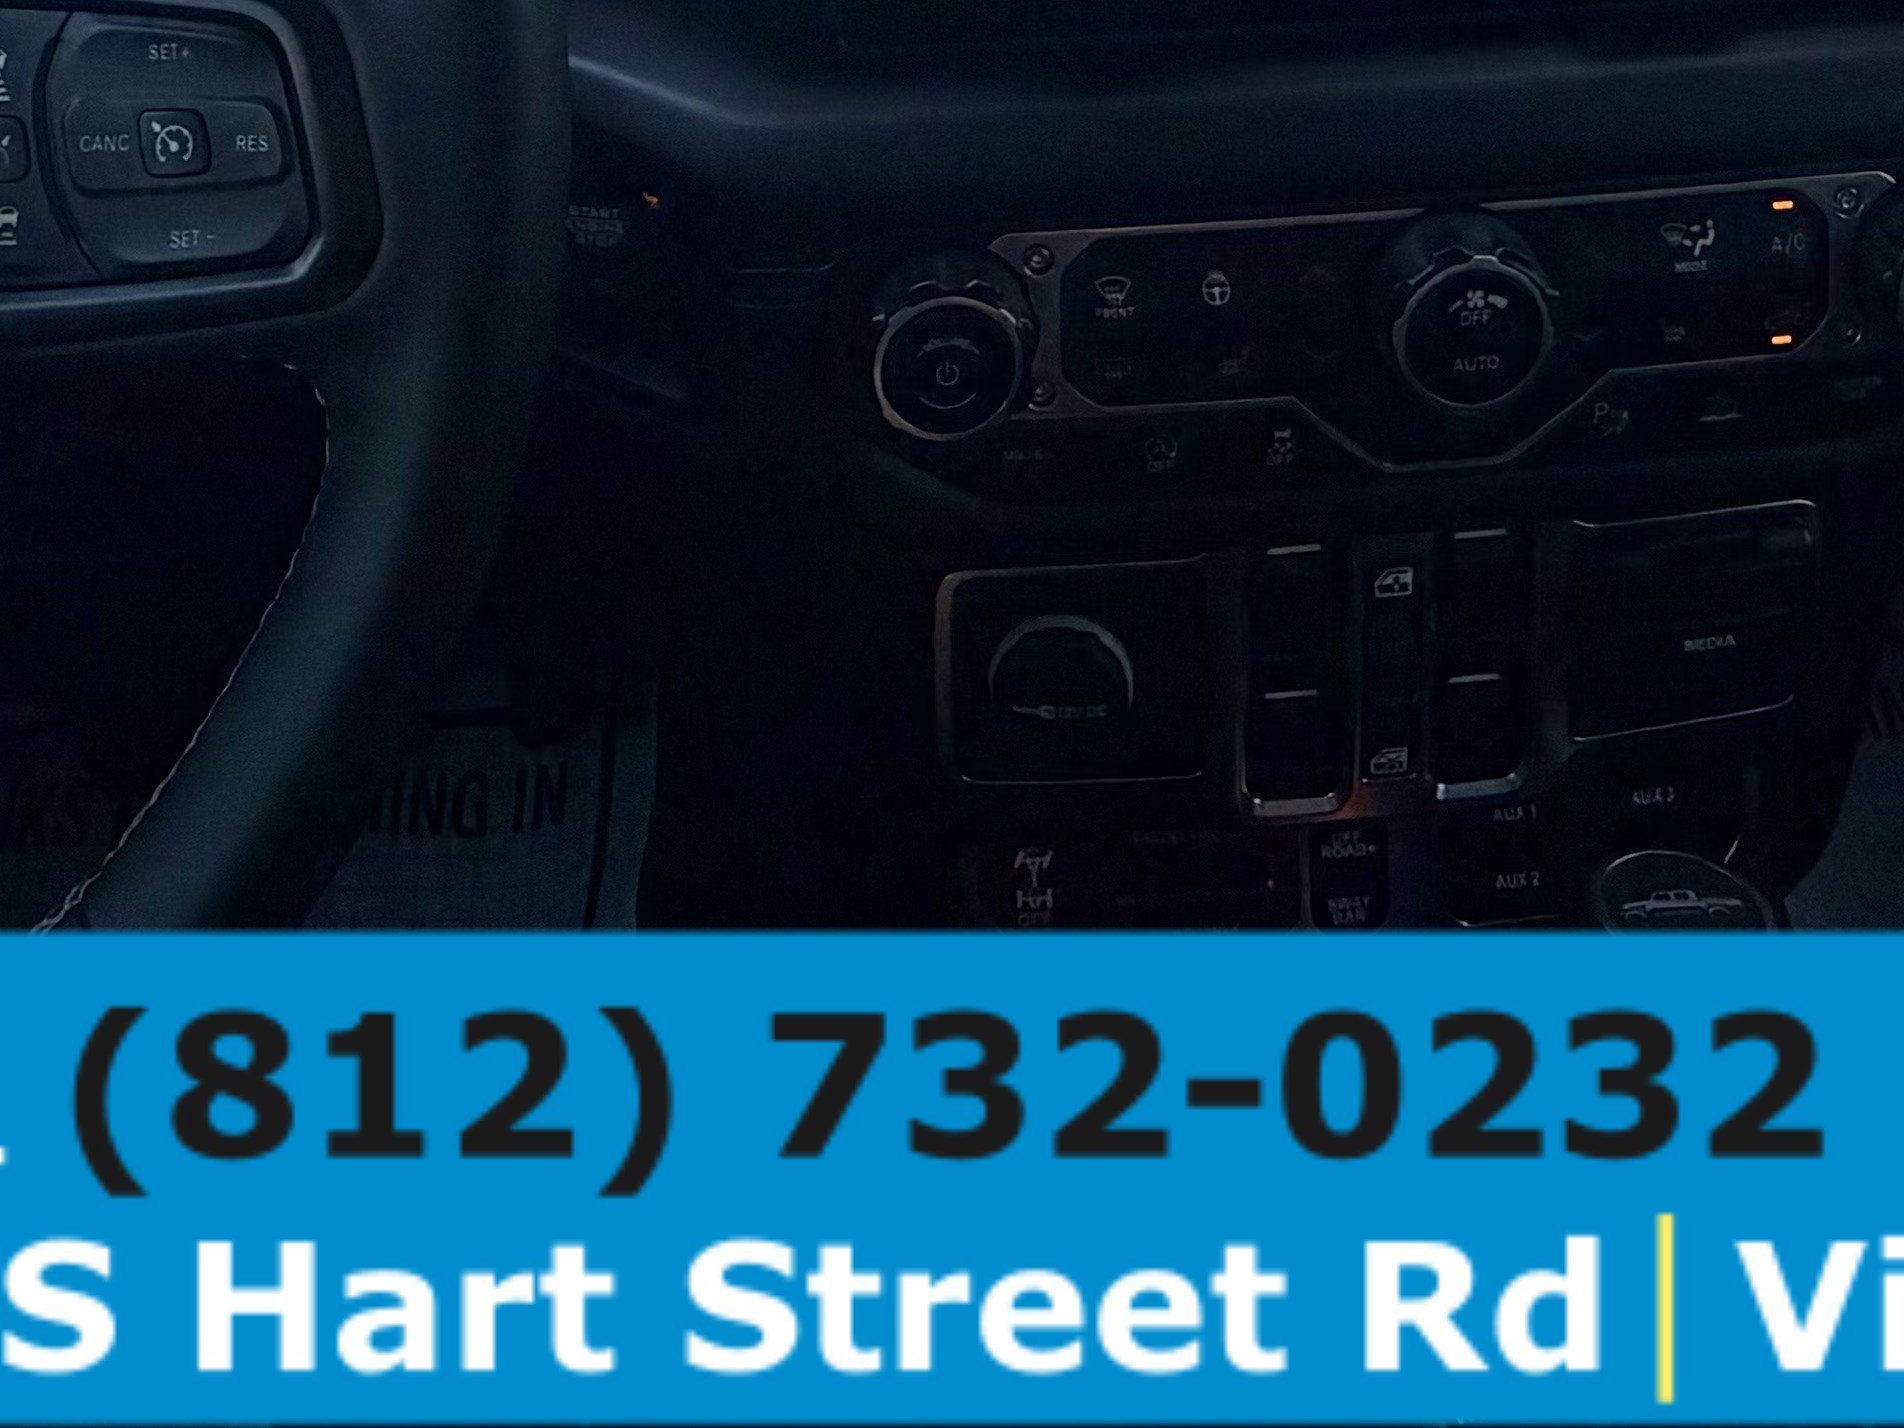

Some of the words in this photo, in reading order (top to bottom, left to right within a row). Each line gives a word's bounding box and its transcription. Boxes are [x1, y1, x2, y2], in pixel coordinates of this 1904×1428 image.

[76, 132, 131, 154] CANC
[233, 132, 271, 154] RES
[1770, 232, 1808, 256] A/C
[1459, 308, 1496, 327] OFF
[1452, 354, 1501, 374] AUTO
[511, 759, 568, 833] IN
